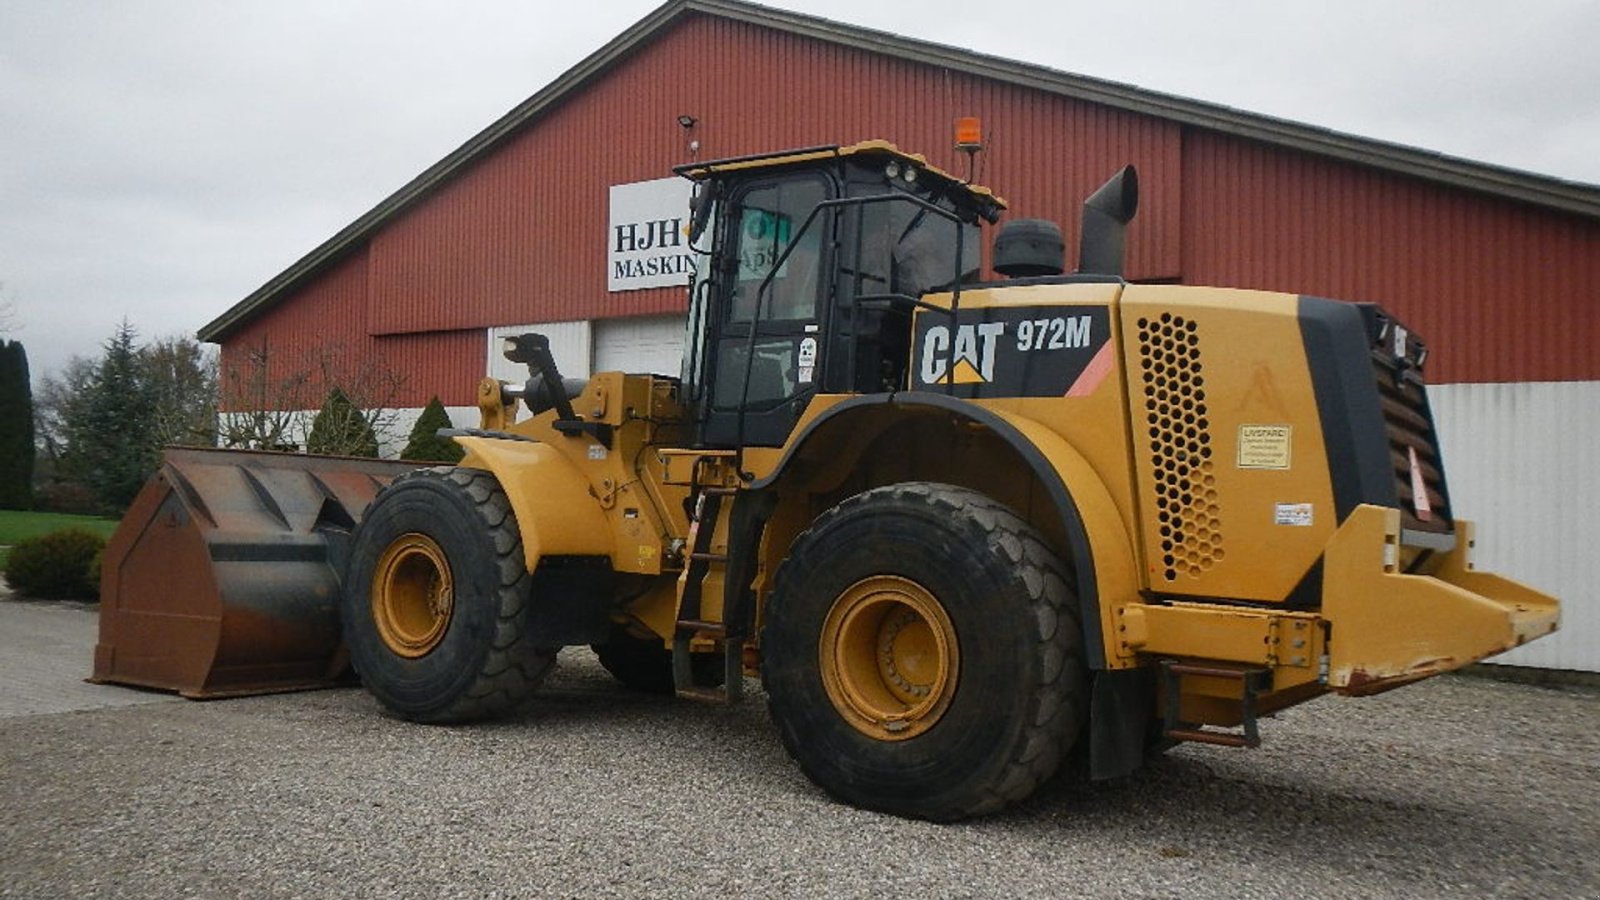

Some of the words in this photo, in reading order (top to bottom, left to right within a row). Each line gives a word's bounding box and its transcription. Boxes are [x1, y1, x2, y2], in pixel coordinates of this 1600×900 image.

[614, 218, 682, 252] HJH
[921, 322, 1004, 384] CAT
[1017, 316, 1091, 351] 972M
